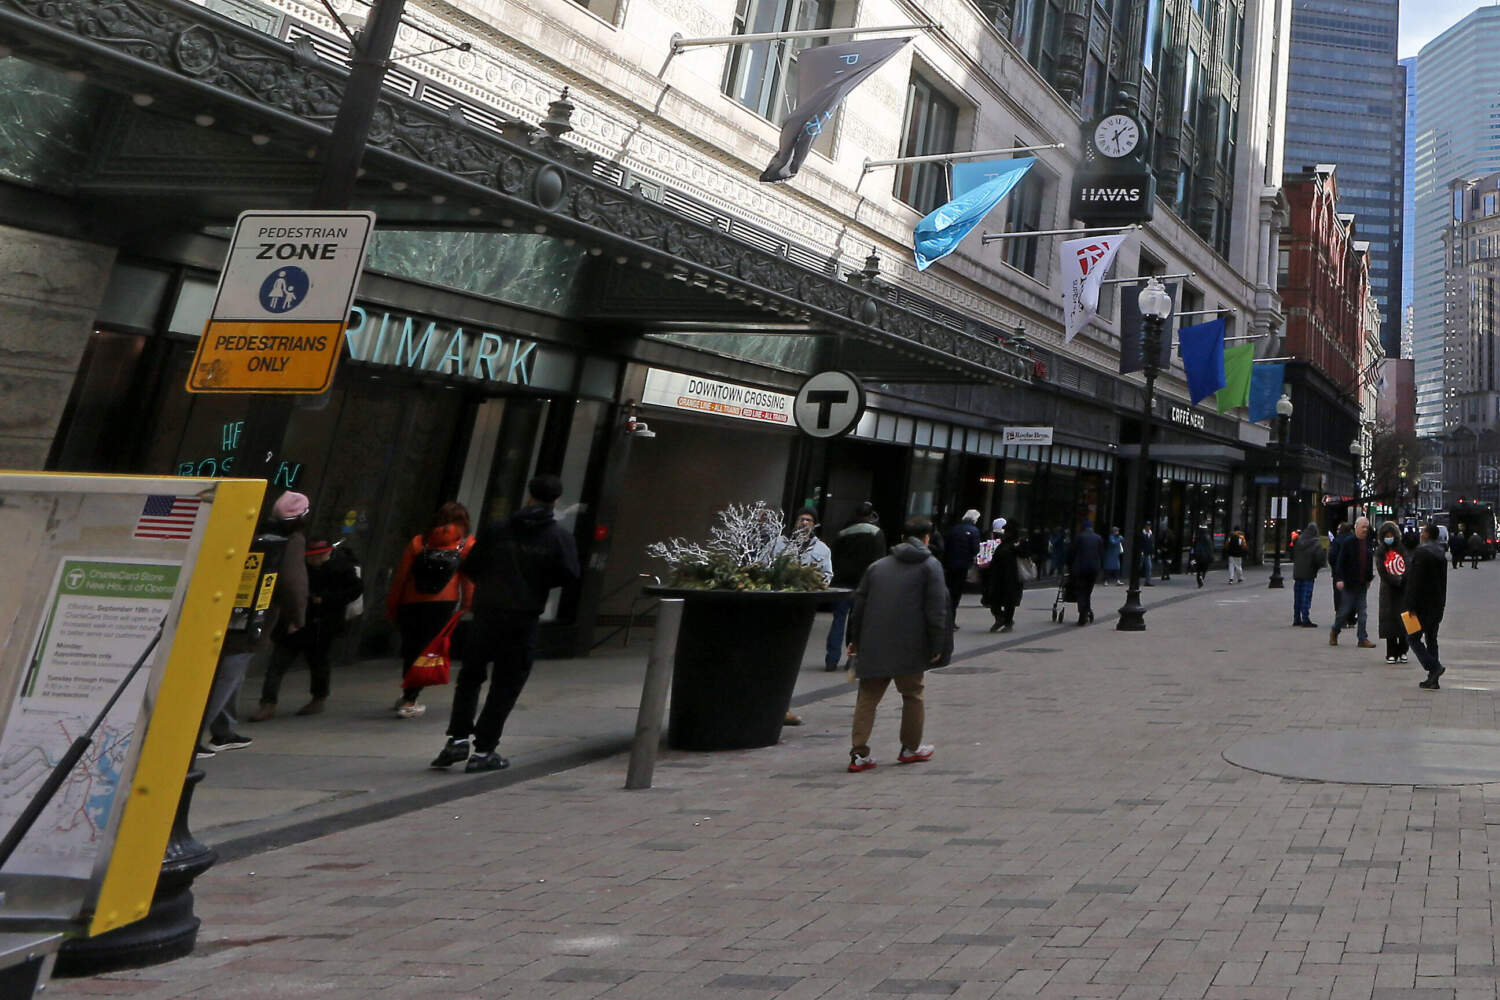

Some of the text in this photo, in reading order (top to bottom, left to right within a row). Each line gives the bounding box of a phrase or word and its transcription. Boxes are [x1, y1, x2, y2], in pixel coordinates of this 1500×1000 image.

[1081, 188, 1140, 201] HAVAS
[258, 227, 348, 238] PEDESTRIAN
[256, 243, 338, 260] ZONE
[215, 335, 328, 351] PEDESTRIANS
[345, 305, 537, 386] RIMARK
[247, 356, 290, 372] ONLY
[688, 379, 785, 410] DOWNTOWN CROSSING
